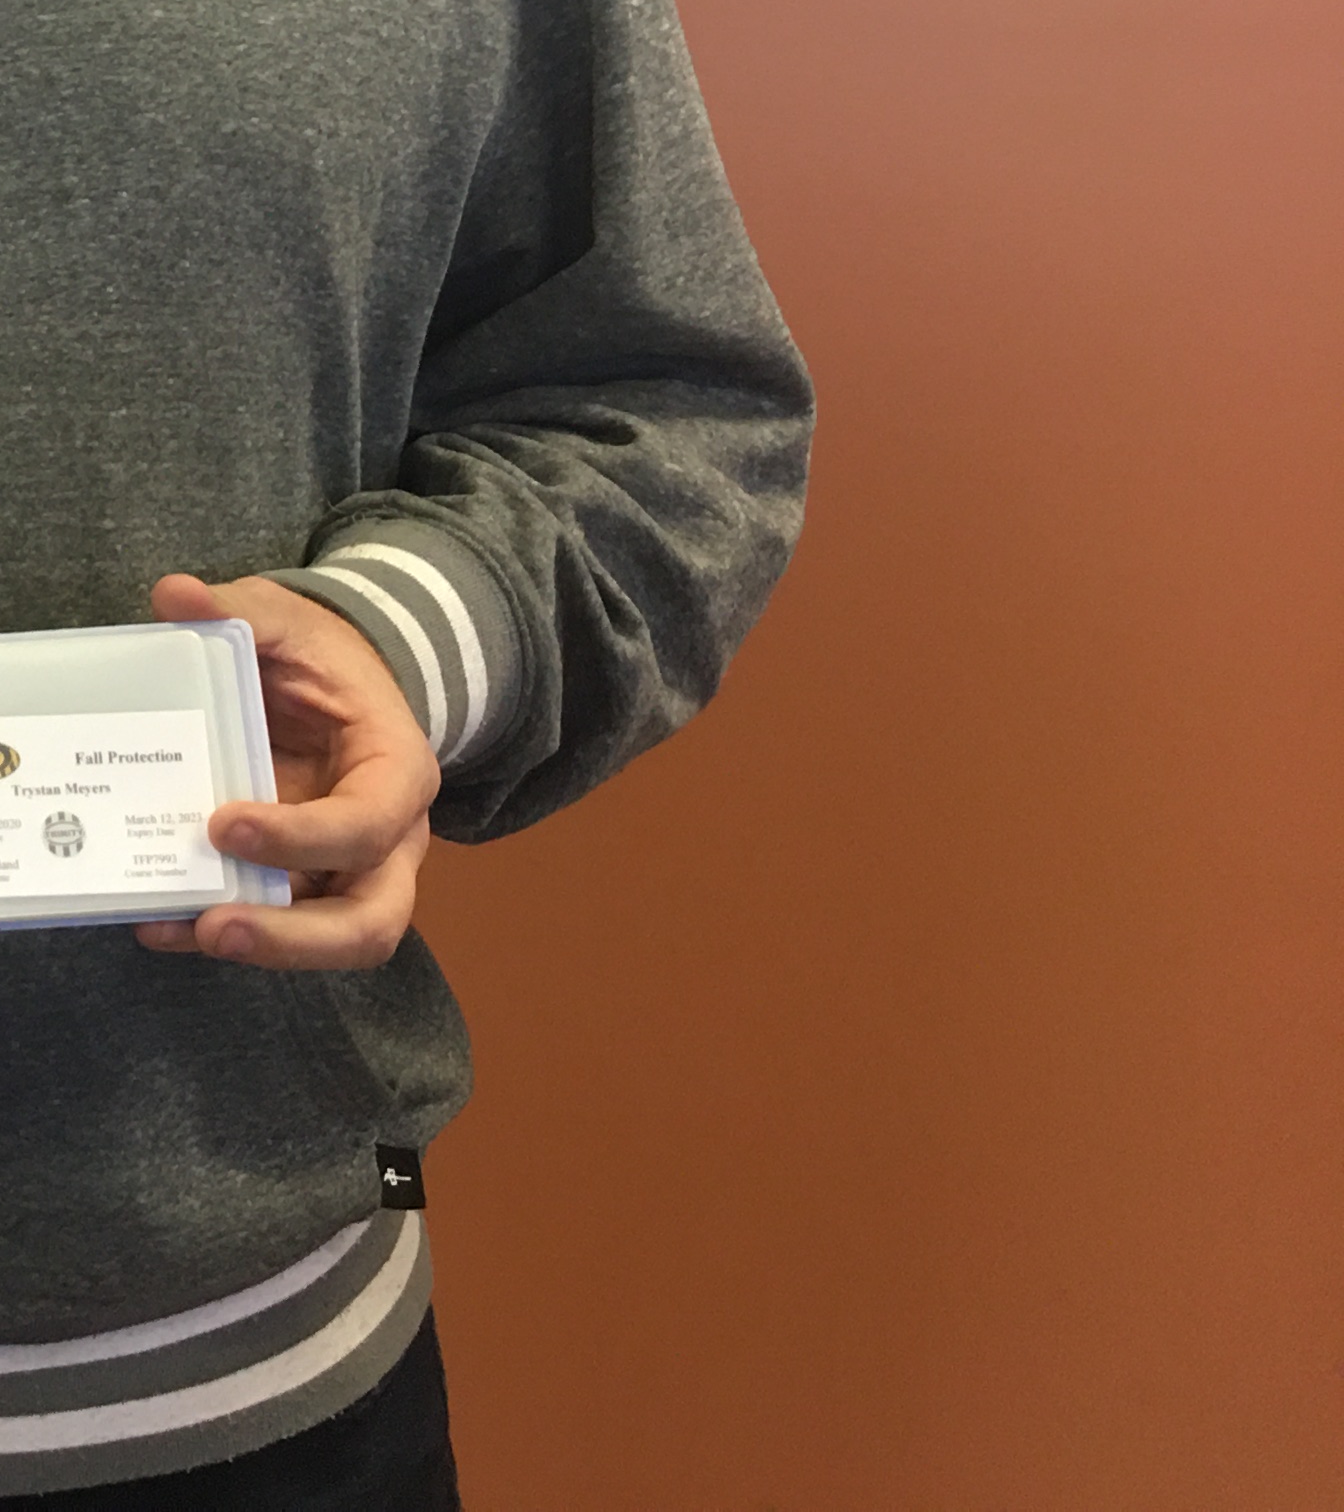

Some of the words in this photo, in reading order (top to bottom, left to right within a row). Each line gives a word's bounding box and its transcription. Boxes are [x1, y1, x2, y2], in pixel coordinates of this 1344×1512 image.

[75, 750, 104, 766] Fall
[108, 749, 183, 765] Protection
[11, 783, 61, 799] Trystan
[65, 782, 111, 797] Meyers
[125, 813, 157, 826] March
